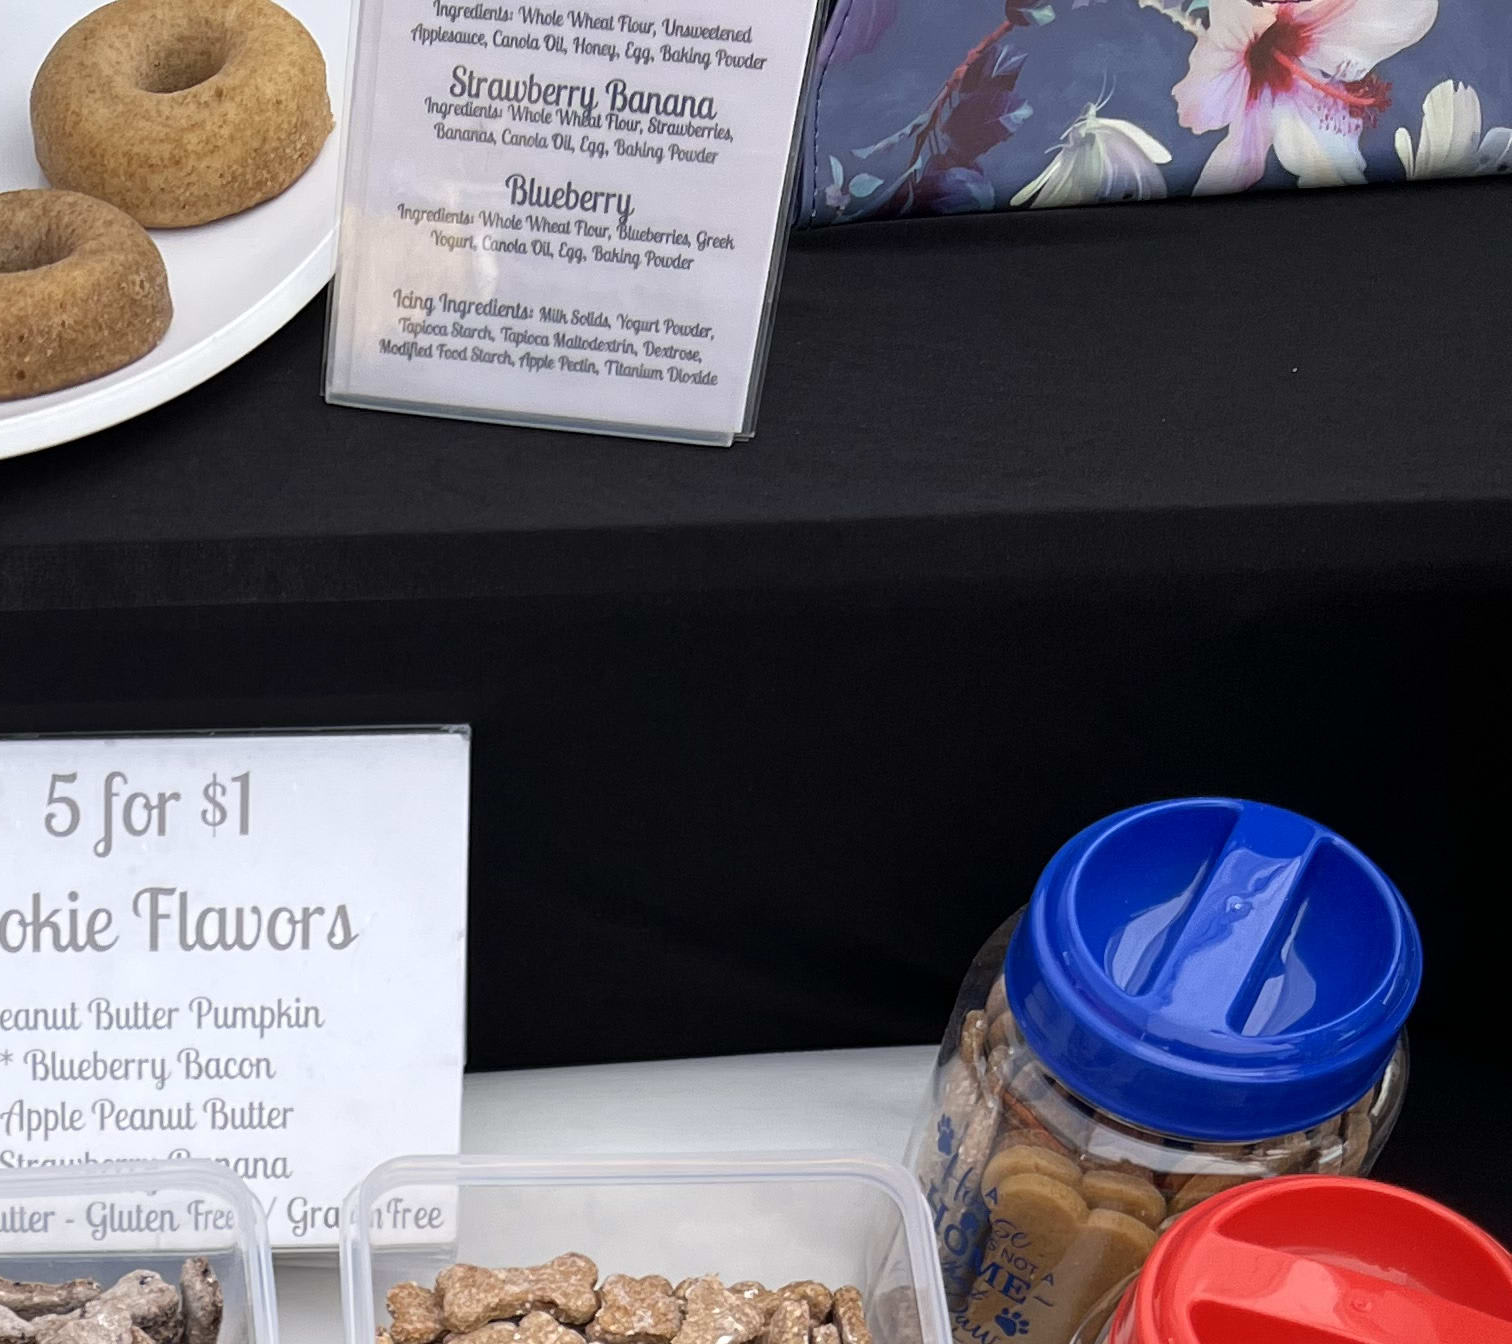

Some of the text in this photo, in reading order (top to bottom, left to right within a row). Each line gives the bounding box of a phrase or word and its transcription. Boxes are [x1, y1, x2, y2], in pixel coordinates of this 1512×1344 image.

[410, 23, 767, 69] Applesauce, Canola Oil, Honey, Egg, Baking Powder
[518, 6, 564, 26] Whole
[567, 10, 615, 31] Wheat
[618, 14, 656, 37] Flour,
[661, 18, 752, 43] Unsweetened
[449, 65, 717, 122] Strawberry Banana
[424, 96, 733, 142] Ingredients: Whole Wheat Flour, Strawberries,
[433, 122, 719, 163] Bananas, Canola Oil, Egg, Baking Powder
[505, 173, 635, 225] Blueberry
[397, 203, 735, 250] Ingredients: Whole Wheat Flour, Blueberries, Greek
[431, 230, 695, 269] Yogurt, Canola Oil, Egg, Baking Powder
[393, 288, 715, 341] Icing Ingredients: Milk Solids, Yogurt Powder,
[378, 338, 434, 361] Modified
[436, 343, 467, 361] Food
[470, 347, 516, 368] Starch,
[519, 352, 555, 372] Apple
[604, 359, 664, 382] Titanium
[666, 366, 719, 387] Dioxide
[398, 317, 702, 364] Tapioca Starch, Tapioca Maltodextrin, Dextrose,
[44, 771, 252, 859] 5 for $1
[132, 887, 361, 953] Flavors
[88, 997, 180, 1032] Butter
[188, 996, 326, 1038] Pumpkin
[23, 1048, 277, 1090] Blueberry Bacon
[90, 1098, 198, 1132] Peanut
[202, 1097, 295, 1131] Butter
[86, 1201, 180, 1241] Gluten
[187, 1200, 236, 1231] Free
[387, 1198, 446, 1230] Free
[1000, 1248, 1038, 1276] NOT
